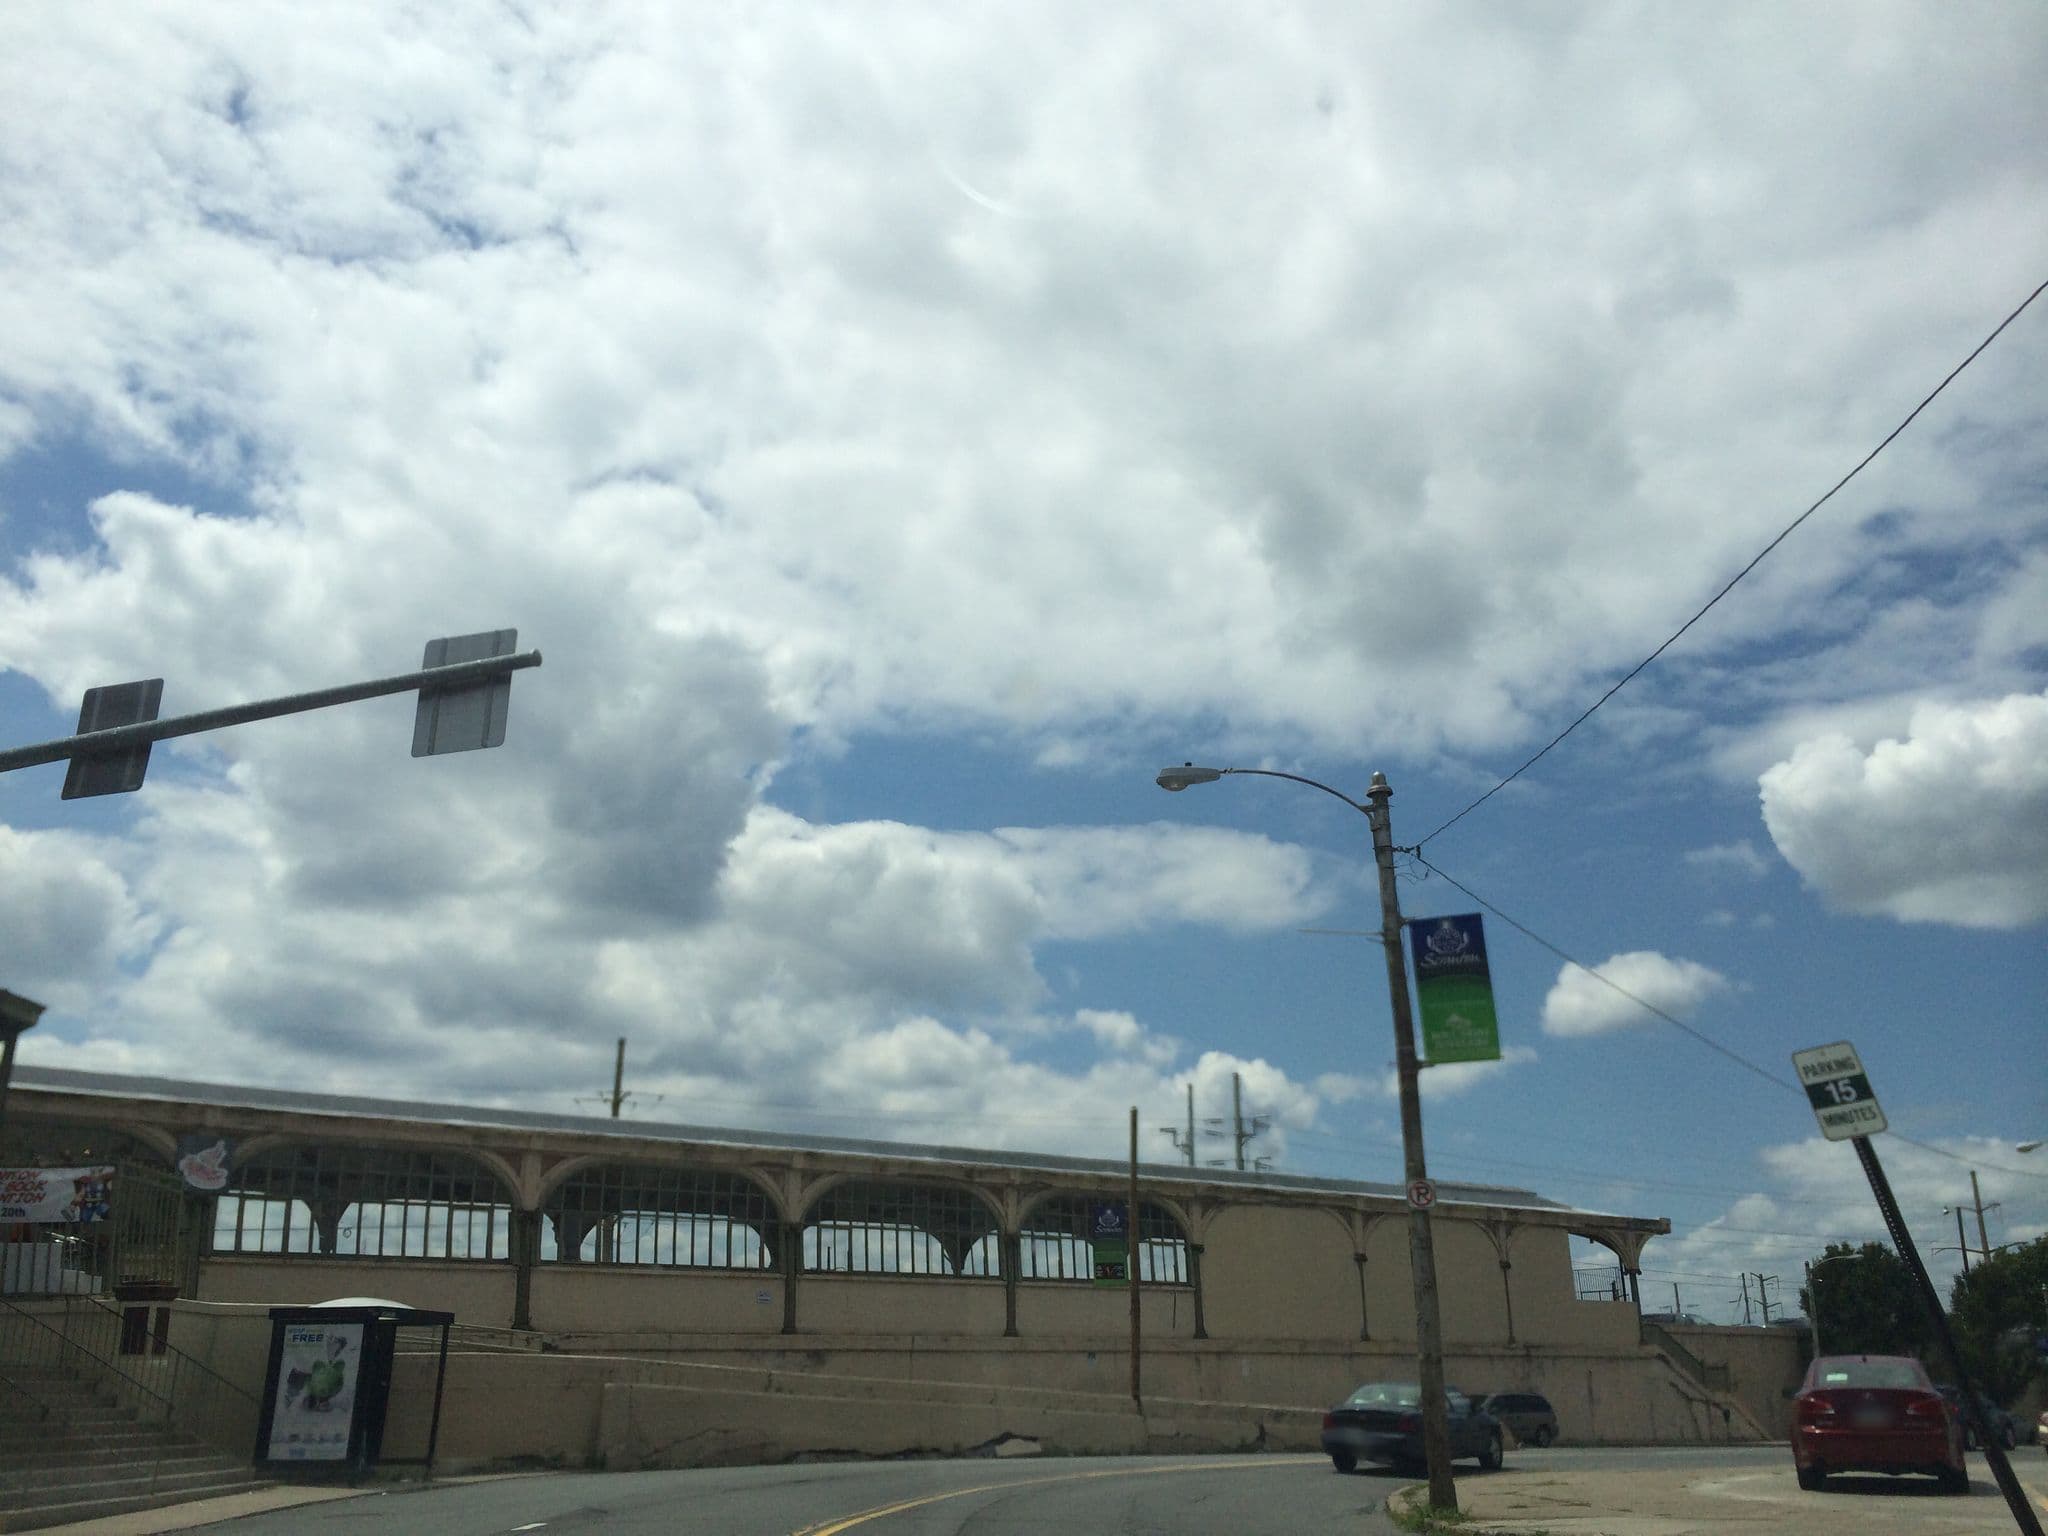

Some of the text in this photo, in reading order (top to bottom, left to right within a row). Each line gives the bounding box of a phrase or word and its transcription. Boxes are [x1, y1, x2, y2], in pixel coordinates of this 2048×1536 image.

[1802, 1056, 1857, 1078] PARKING
[1825, 1078, 1857, 1103] 15
[1823, 1105, 1877, 1127] MINUTES
[293, 1333, 324, 1342] FREE
